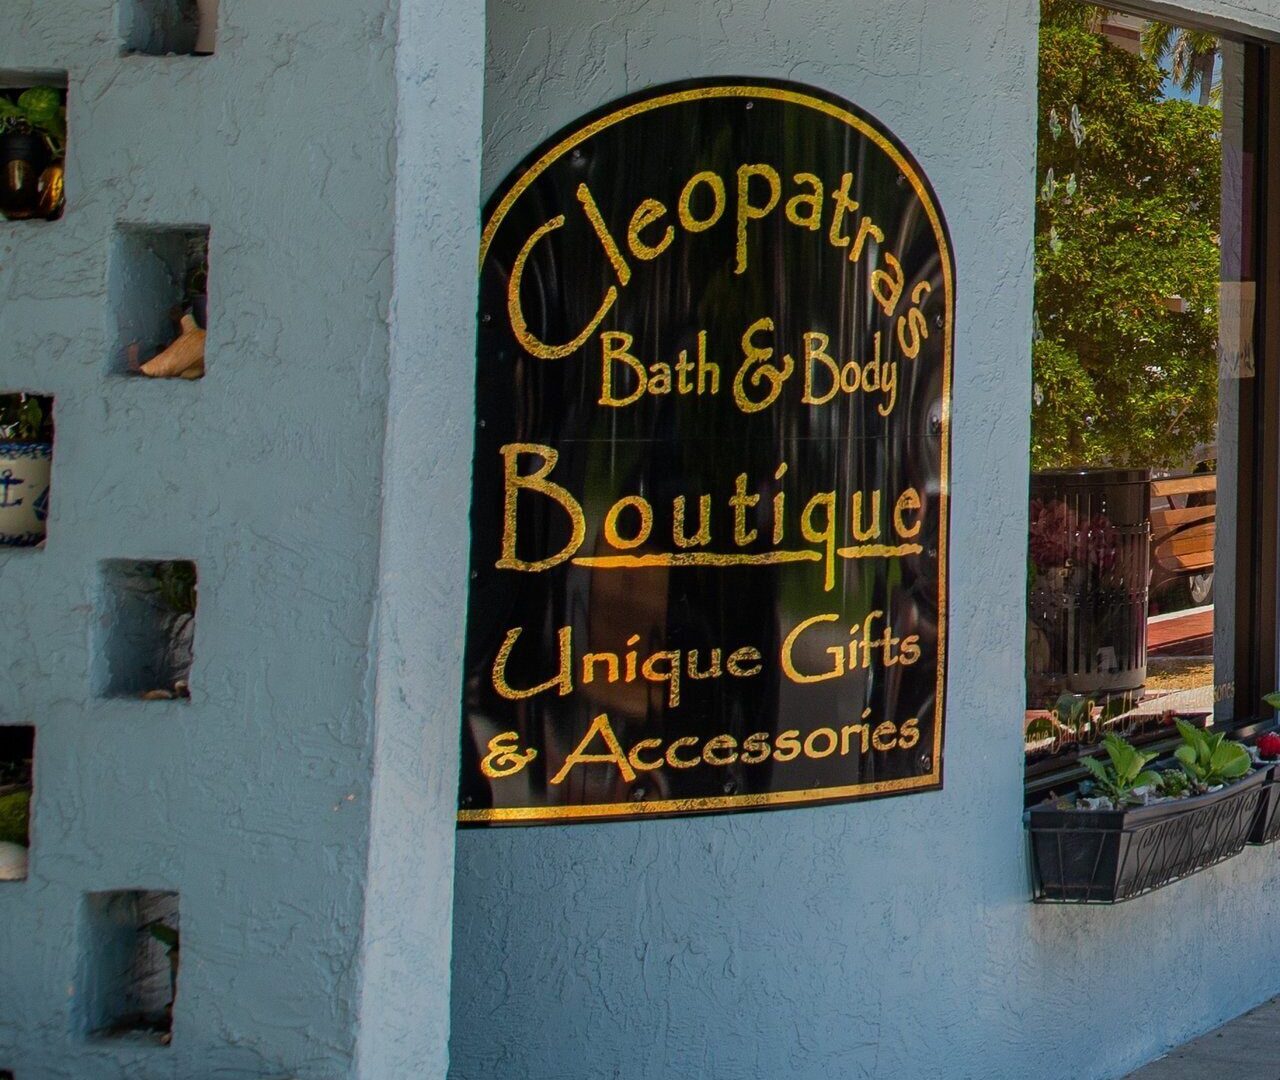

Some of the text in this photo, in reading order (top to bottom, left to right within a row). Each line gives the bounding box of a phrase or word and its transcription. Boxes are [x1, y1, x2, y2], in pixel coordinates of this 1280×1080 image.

[508, 163, 931, 360] Cleopatra's
[598, 317, 899, 418] Bath & Body
[495, 442, 923, 592] Boutique
[492, 610, 922, 707] Unique Gifts
[481, 707, 921, 784] & Accessories
